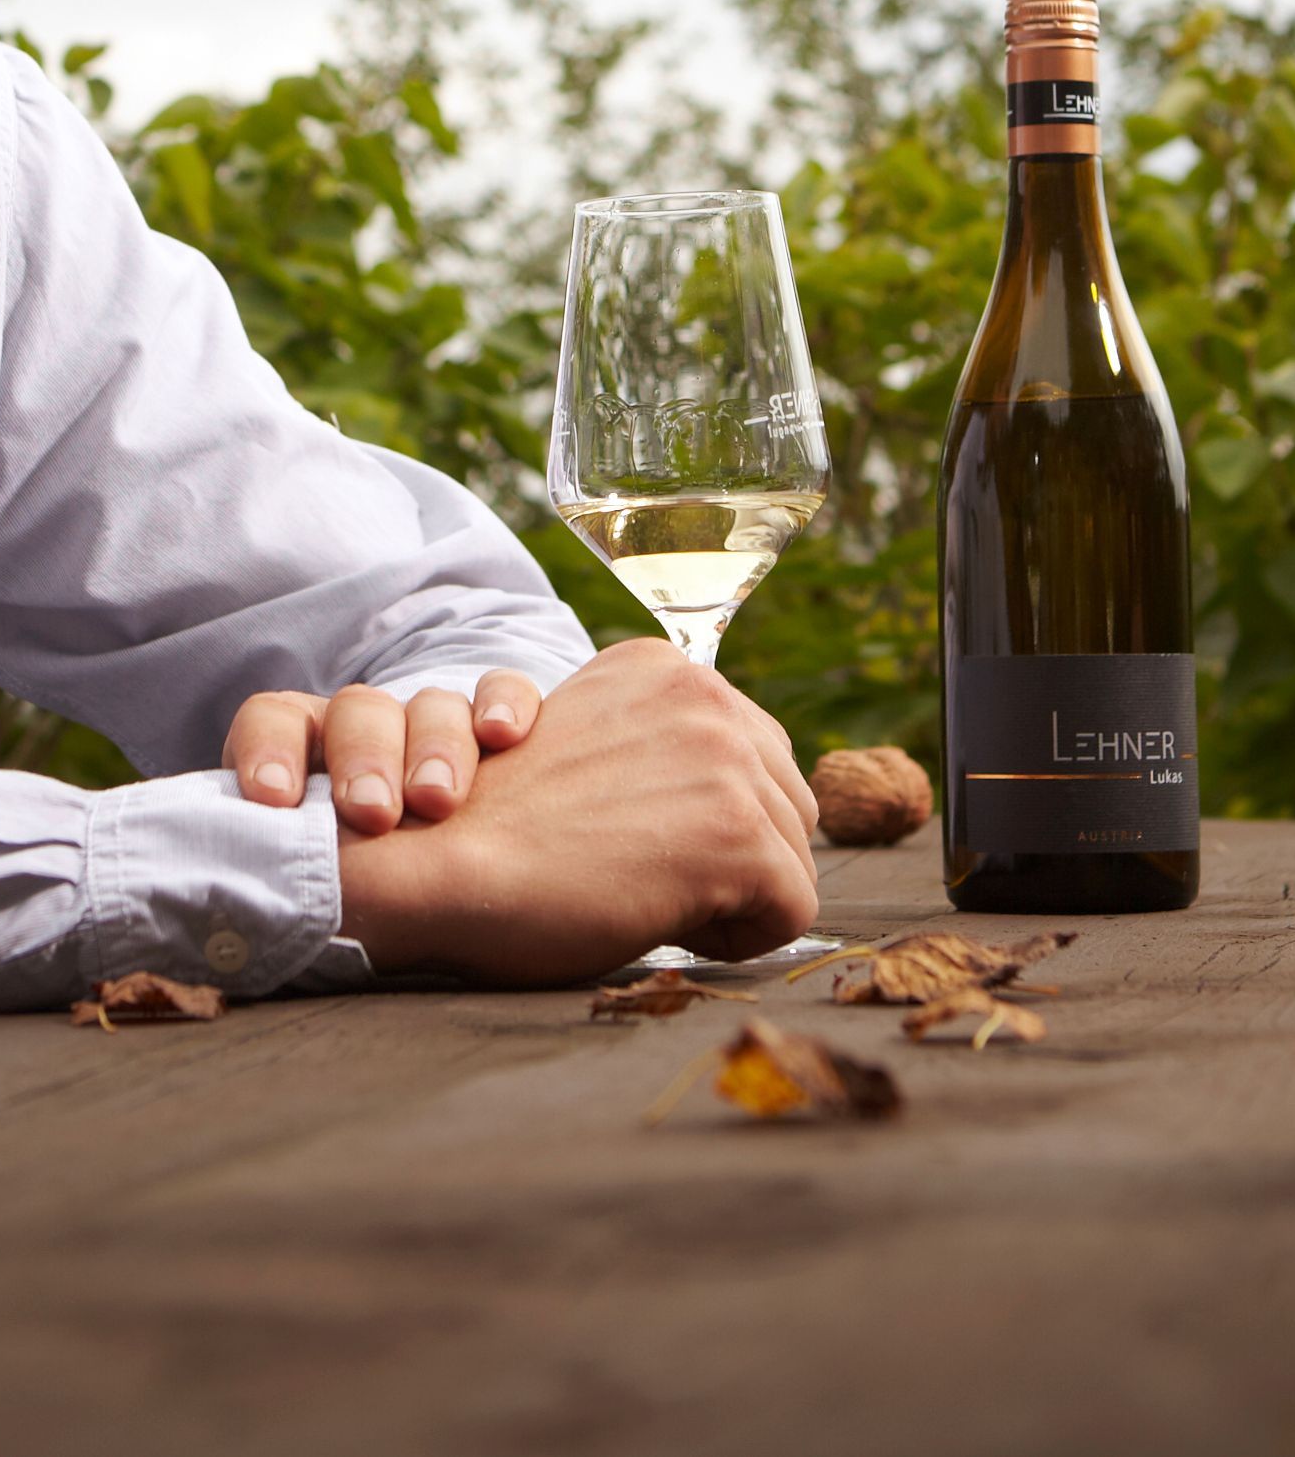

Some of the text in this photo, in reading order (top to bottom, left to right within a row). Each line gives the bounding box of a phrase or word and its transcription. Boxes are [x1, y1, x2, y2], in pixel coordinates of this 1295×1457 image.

[1052, 82, 1101, 113] LEHNE
[1052, 710, 1176, 761] LEHNER
[1150, 768, 1183, 784] Lukas
